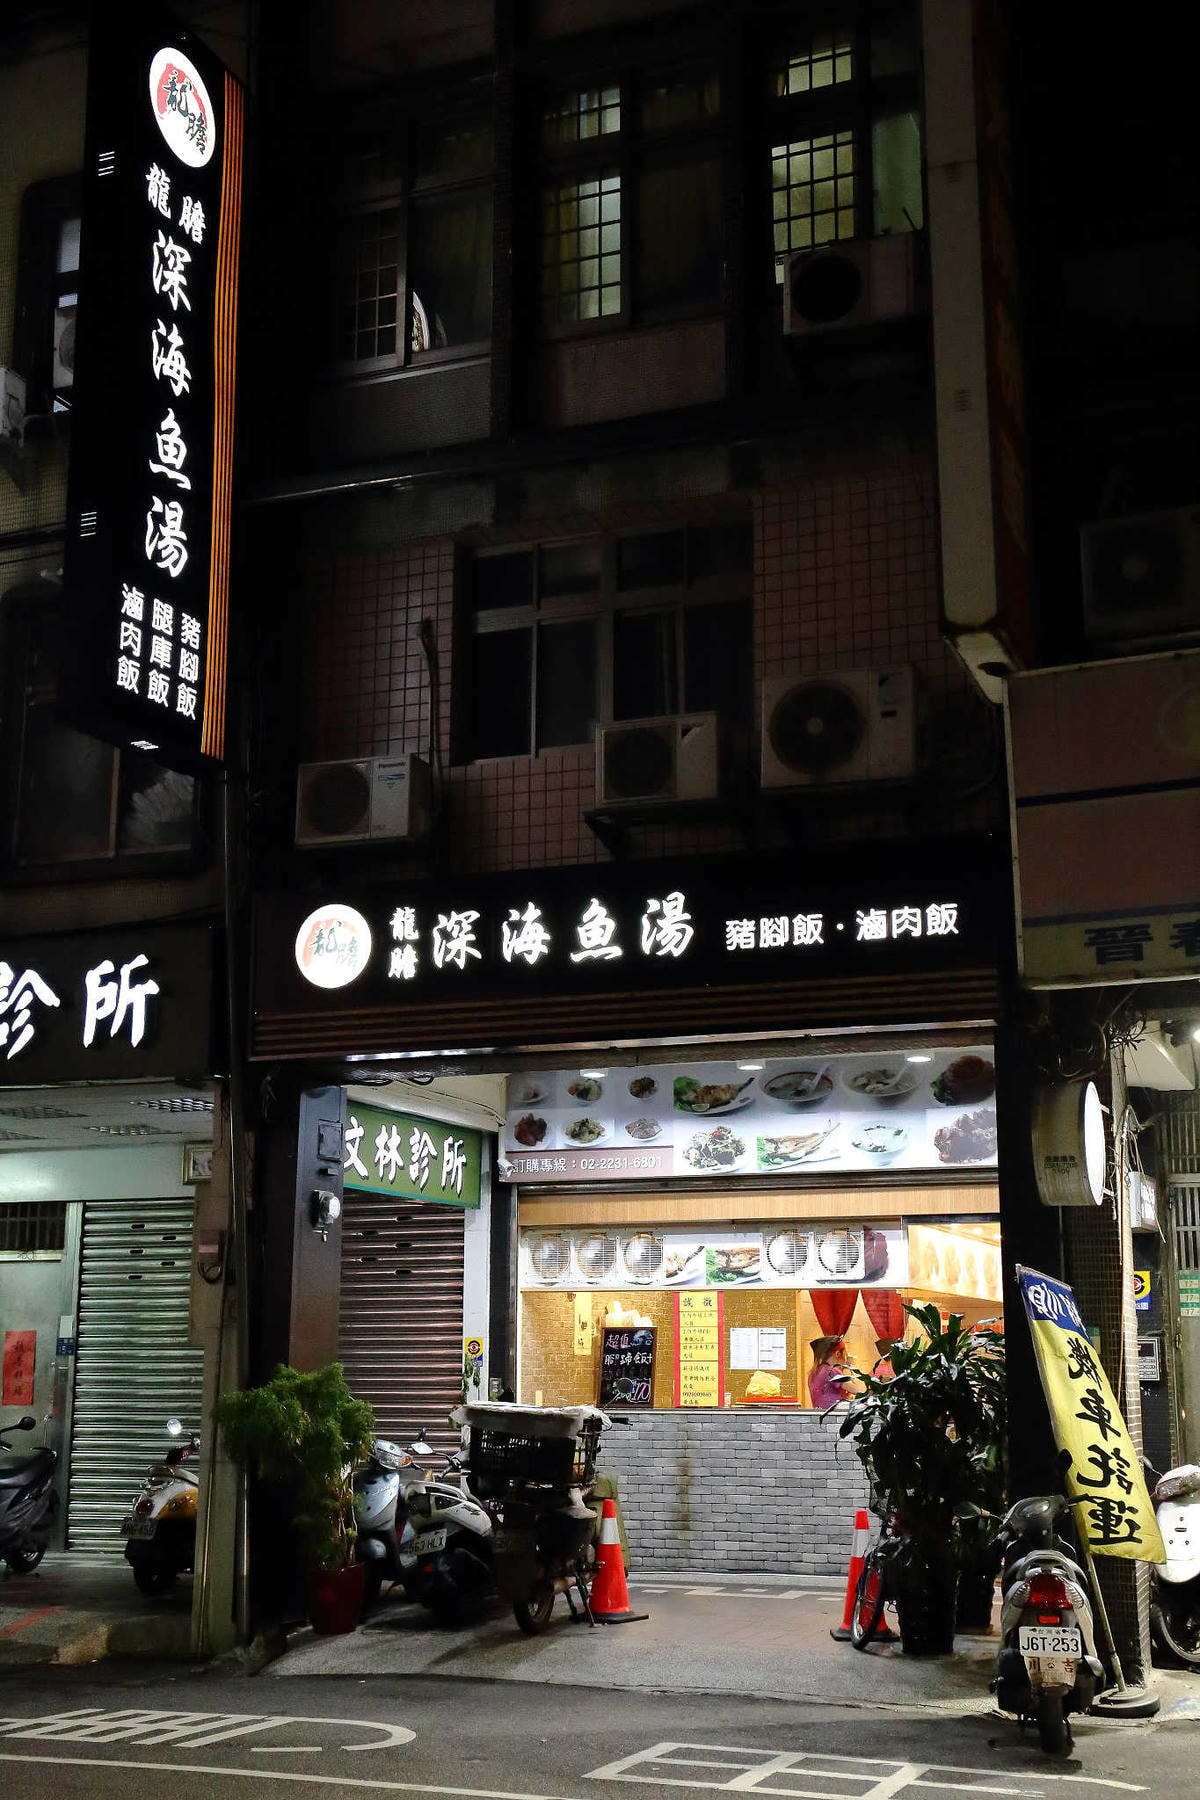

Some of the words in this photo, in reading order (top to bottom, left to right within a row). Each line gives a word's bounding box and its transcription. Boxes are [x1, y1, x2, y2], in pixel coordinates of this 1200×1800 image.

[117, 584, 144, 694] 滷肉飯
[176, 613, 200, 720] 豬腳飯
[344, 1115, 467, 1197] 文林診所
